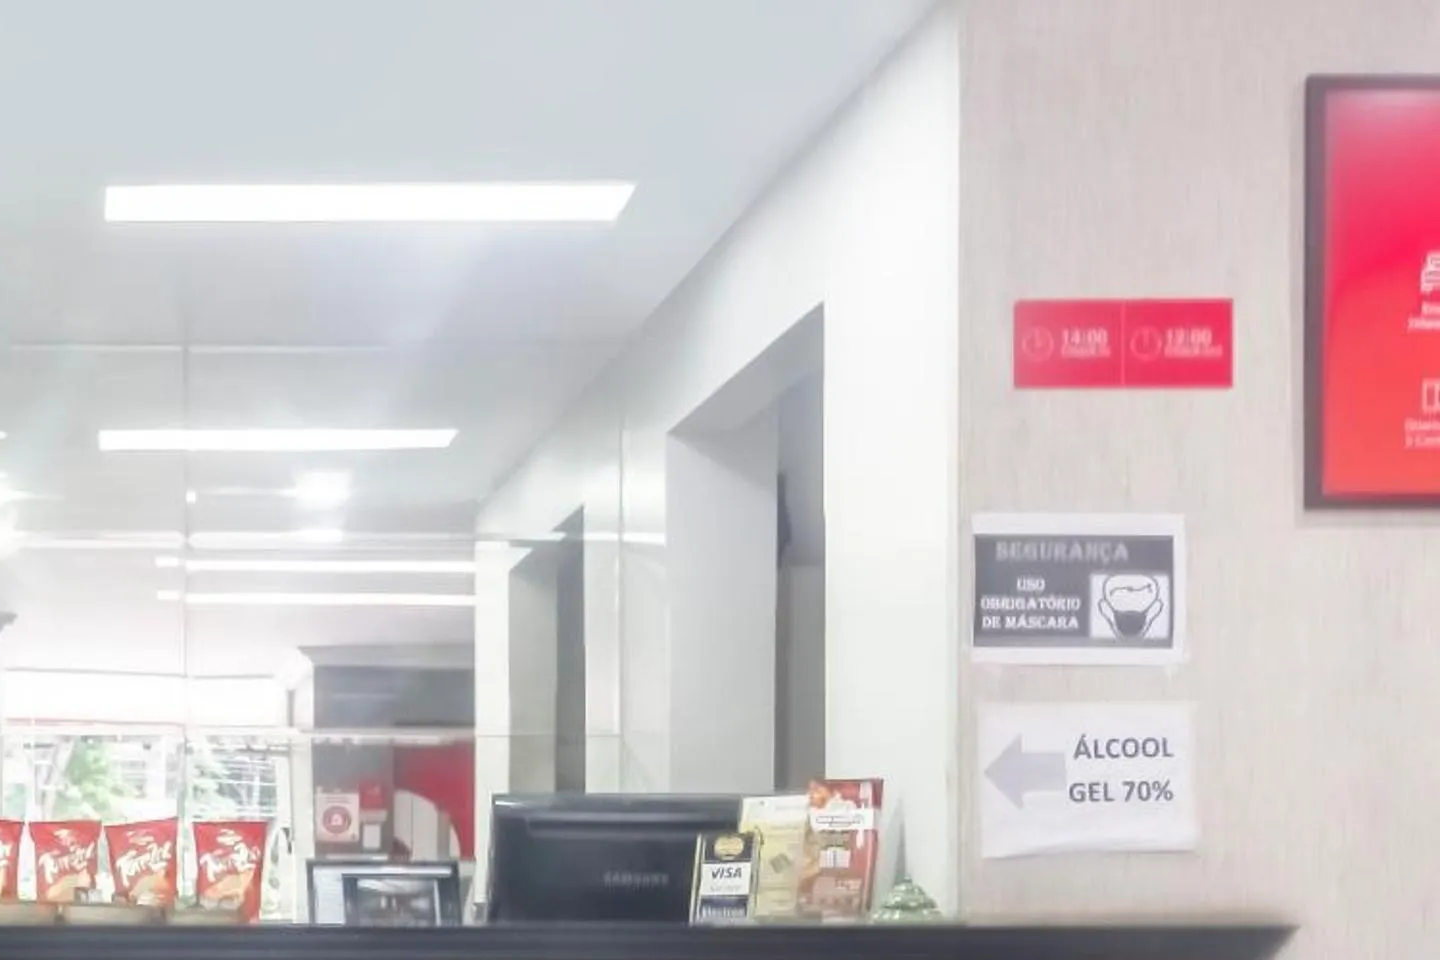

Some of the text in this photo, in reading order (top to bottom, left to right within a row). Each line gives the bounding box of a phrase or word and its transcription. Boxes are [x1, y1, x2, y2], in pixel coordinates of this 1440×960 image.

[1016, 577, 1046, 592] USO
[982, 611, 1079, 629] DE MÁSCARA
[1073, 734, 1175, 759] ÁLCOOL
[1069, 780, 1174, 803] GEL 70%
[712, 867, 742, 879] VISA
